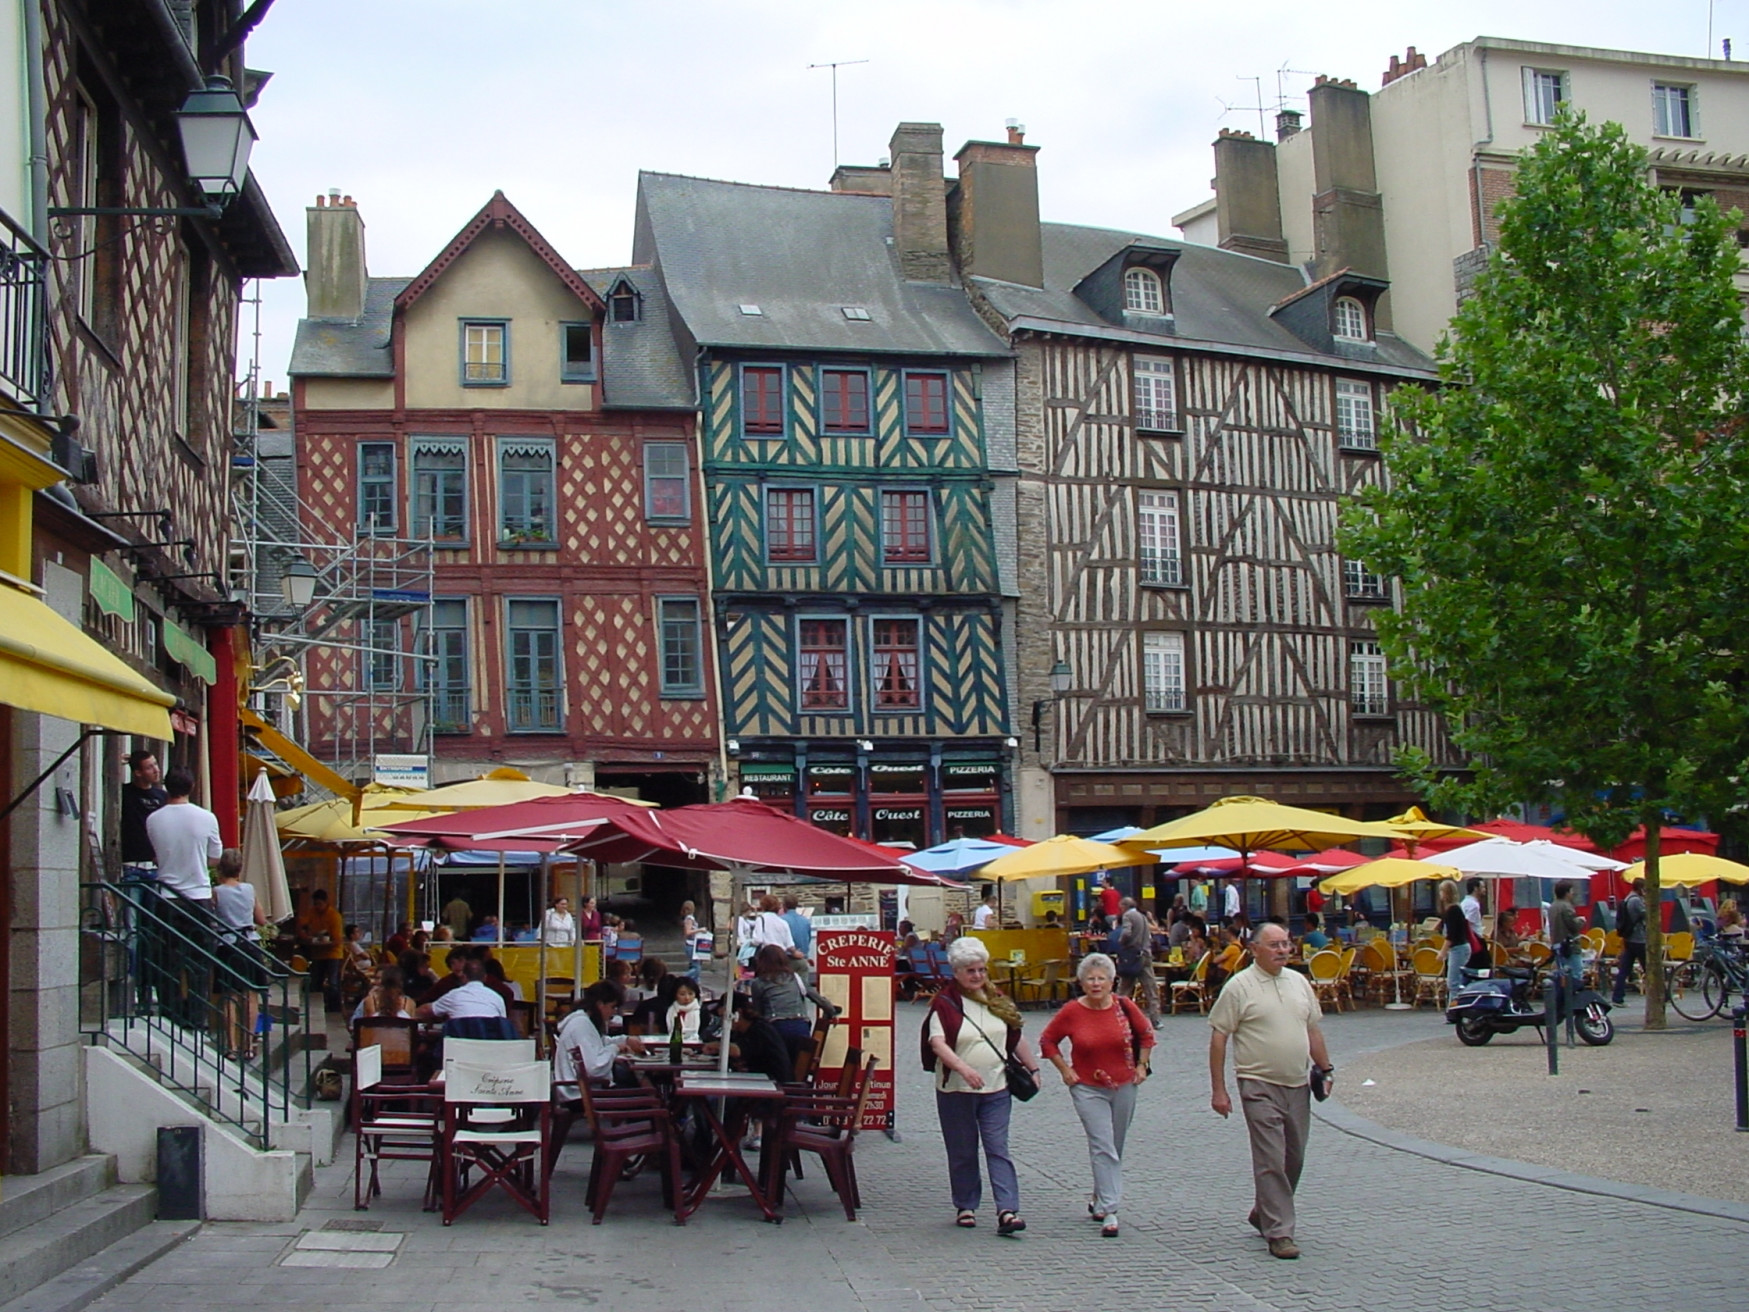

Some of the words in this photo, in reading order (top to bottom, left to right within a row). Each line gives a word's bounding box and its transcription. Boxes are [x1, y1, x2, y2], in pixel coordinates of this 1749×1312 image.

[949, 765, 996, 774] PIZZERIA
[744, 774, 792, 782] RESTAURANT
[812, 810, 849, 821] Côte
[875, 809, 921, 820] Ouest
[947, 811, 991, 819] PIZZERIA
[817, 934, 895, 957] CREPERIE
[826, 955, 847, 968] Ste
[848, 955, 889, 968] ANNE
[855, 1080, 892, 1089] ctinue
